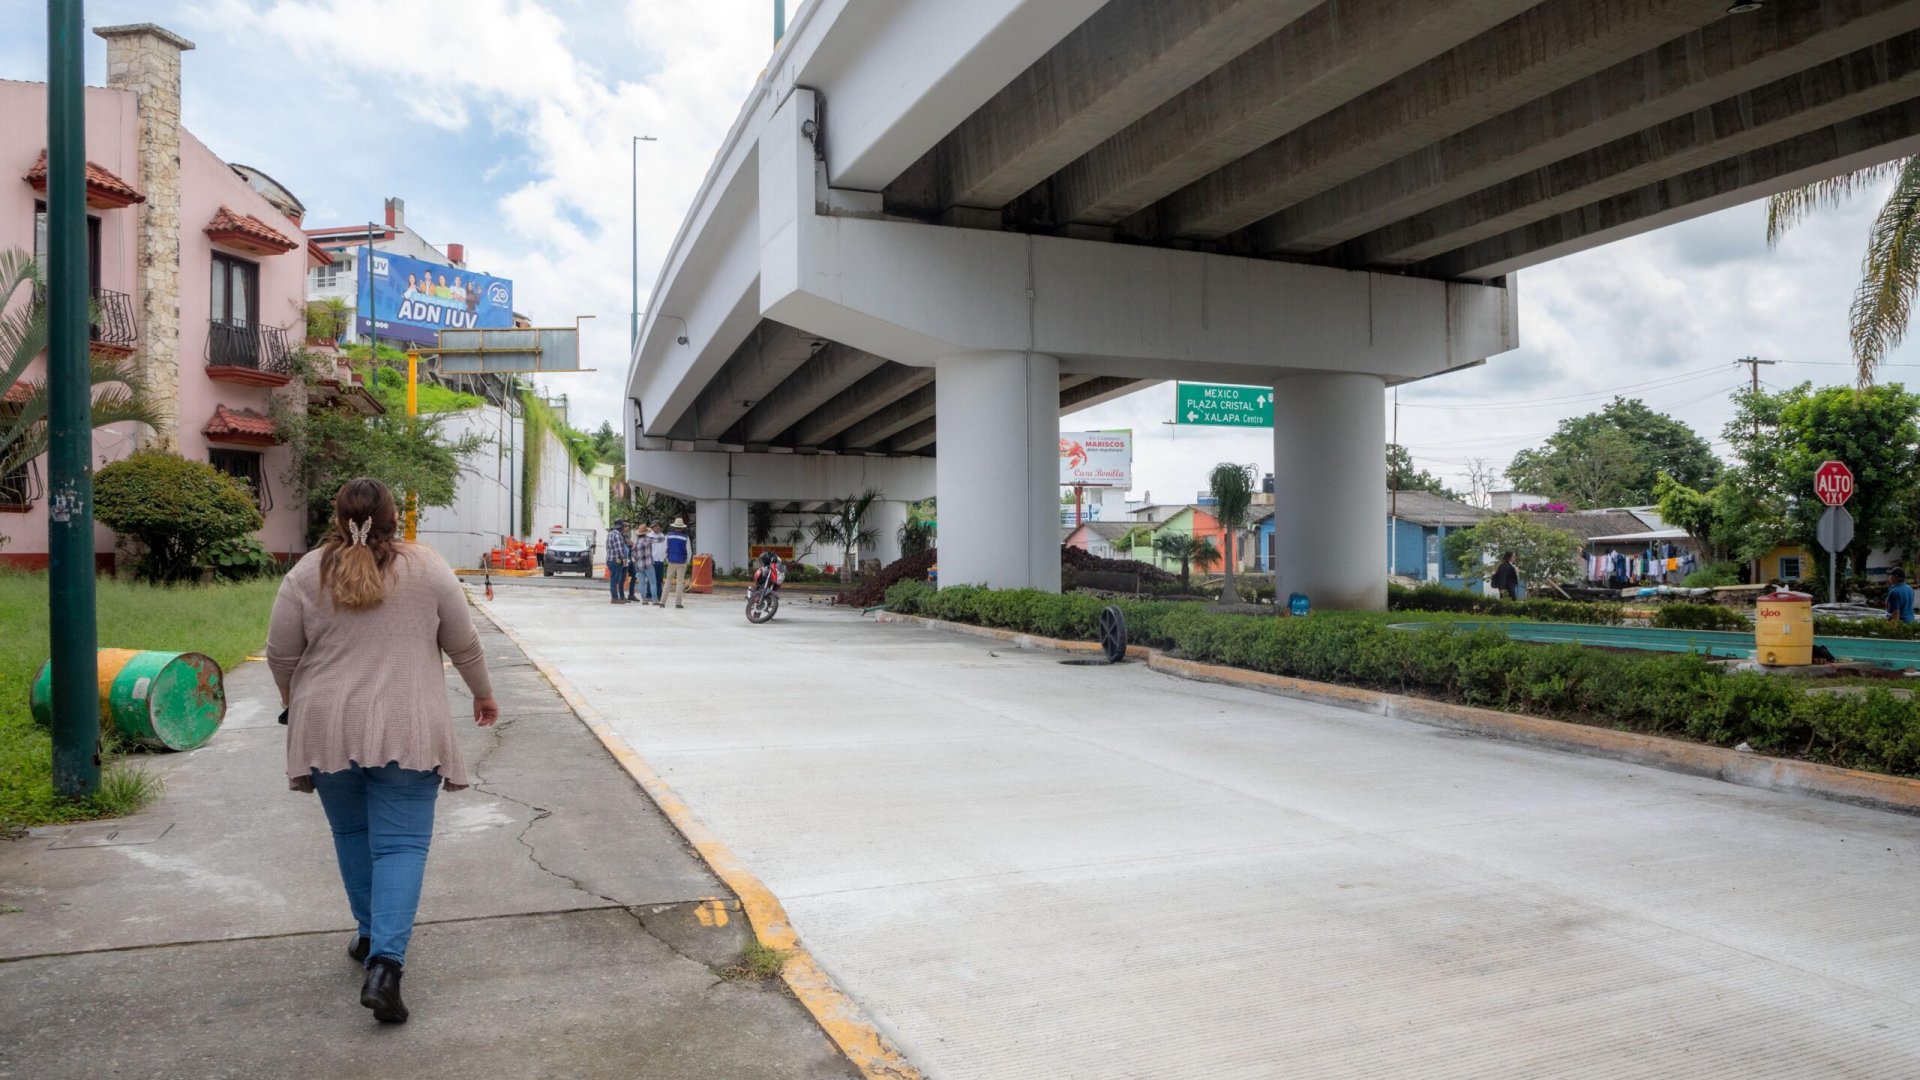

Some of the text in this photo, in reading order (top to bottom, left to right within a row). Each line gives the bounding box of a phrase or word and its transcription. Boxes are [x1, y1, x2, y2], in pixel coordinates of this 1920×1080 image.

[398, 300, 441, 324] ADN
[445, 308, 478, 328] IUV
[1204, 389, 1239, 399] MEXICO
[1187, 399, 1254, 411] PLAZA CRISTAL
[1204, 412, 1264, 424] XALAPA Centro
[1074, 467, 1125, 477] Casa Bonilla
[1818, 475, 1850, 492] ALTO
[1825, 492, 1843, 504] 1X1
[1760, 607, 1780, 619] igloo
